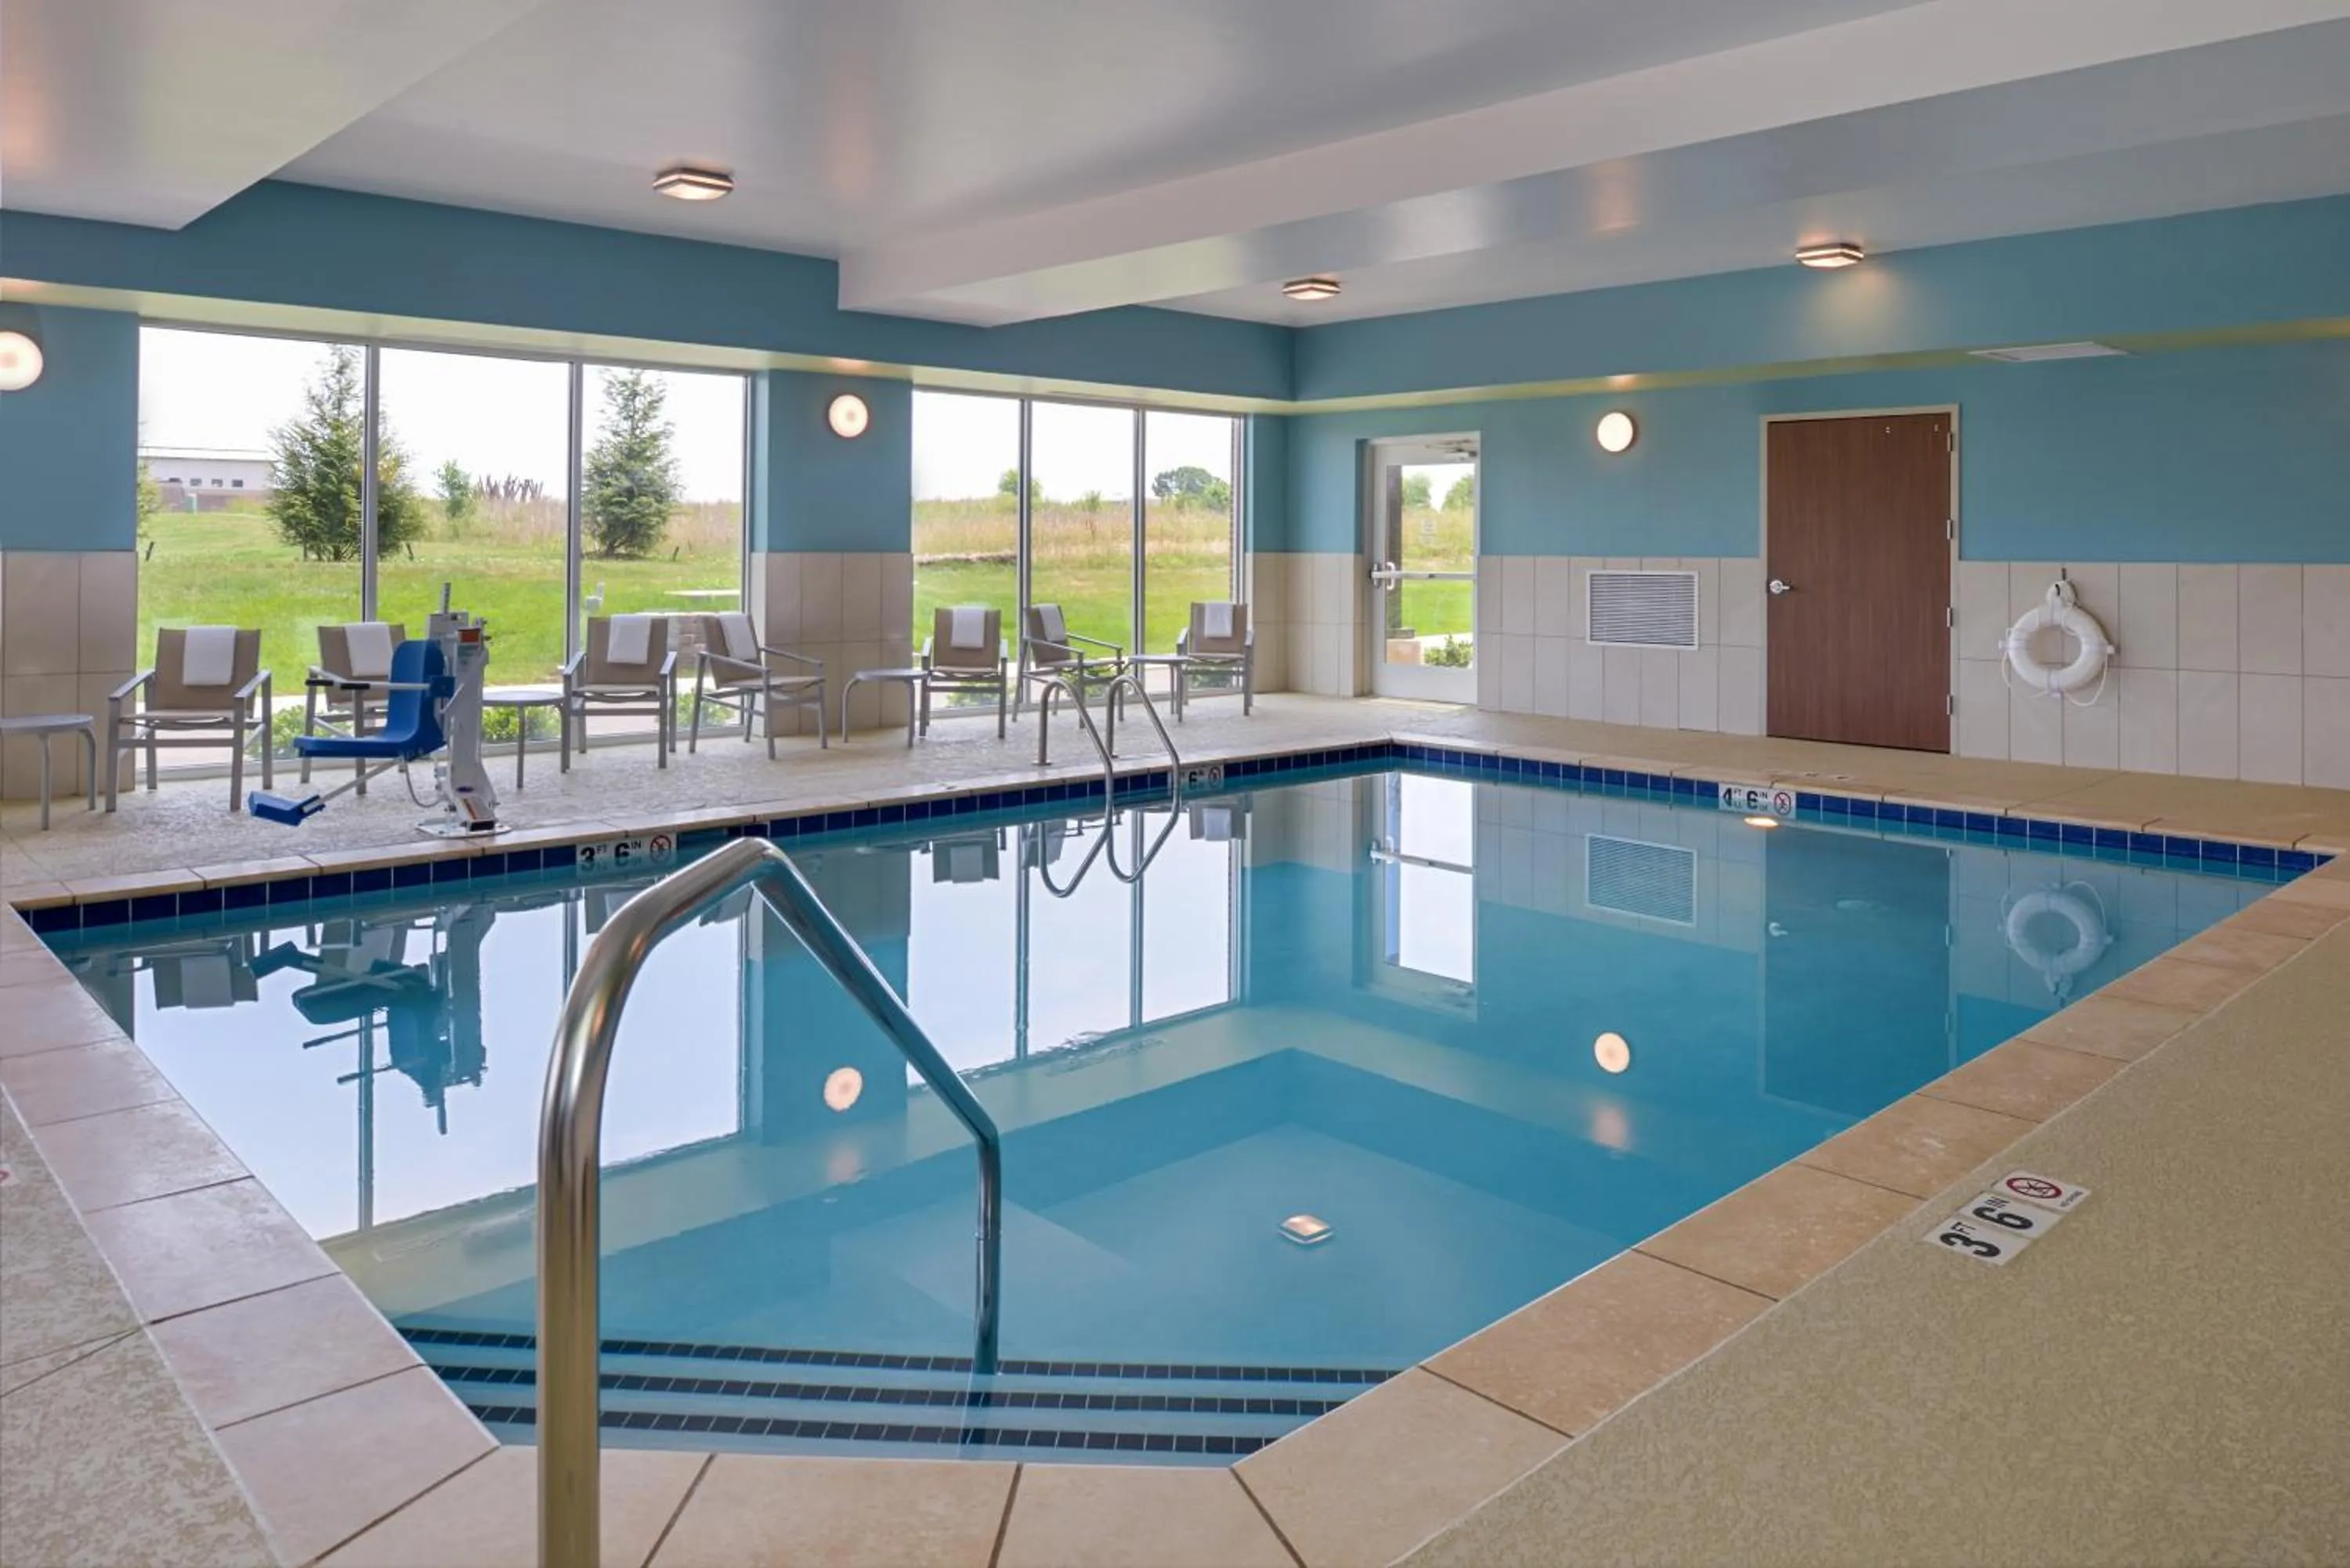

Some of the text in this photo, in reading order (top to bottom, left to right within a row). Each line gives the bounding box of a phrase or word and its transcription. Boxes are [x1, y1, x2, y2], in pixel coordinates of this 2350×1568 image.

[1950, 1221, 1976, 1235] FT
[1972, 1206, 2034, 1230] 6
[1940, 1232, 2001, 1258] 3
